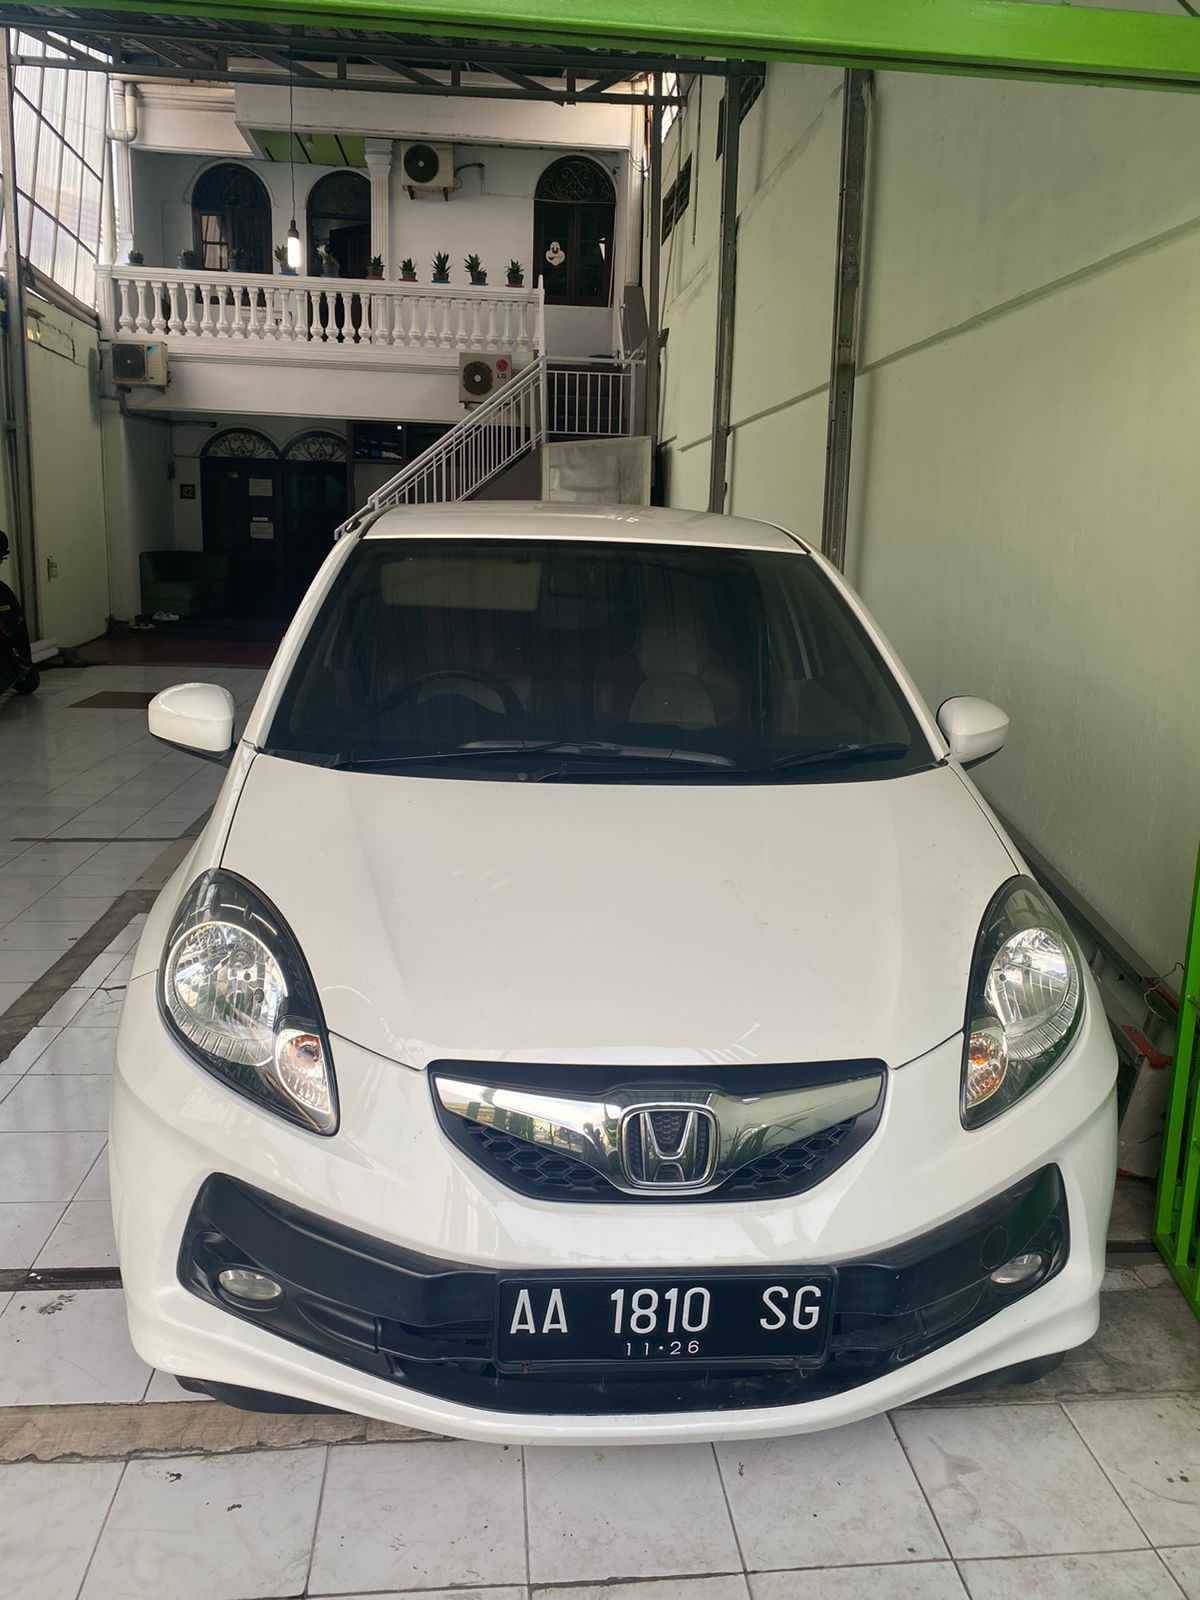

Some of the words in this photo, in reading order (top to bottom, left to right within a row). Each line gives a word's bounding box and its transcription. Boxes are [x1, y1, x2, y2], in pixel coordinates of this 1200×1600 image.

[509, 1288, 569, 1334] AA
[609, 1287, 711, 1334] 1810
[759, 1285, 822, 1331] SG
